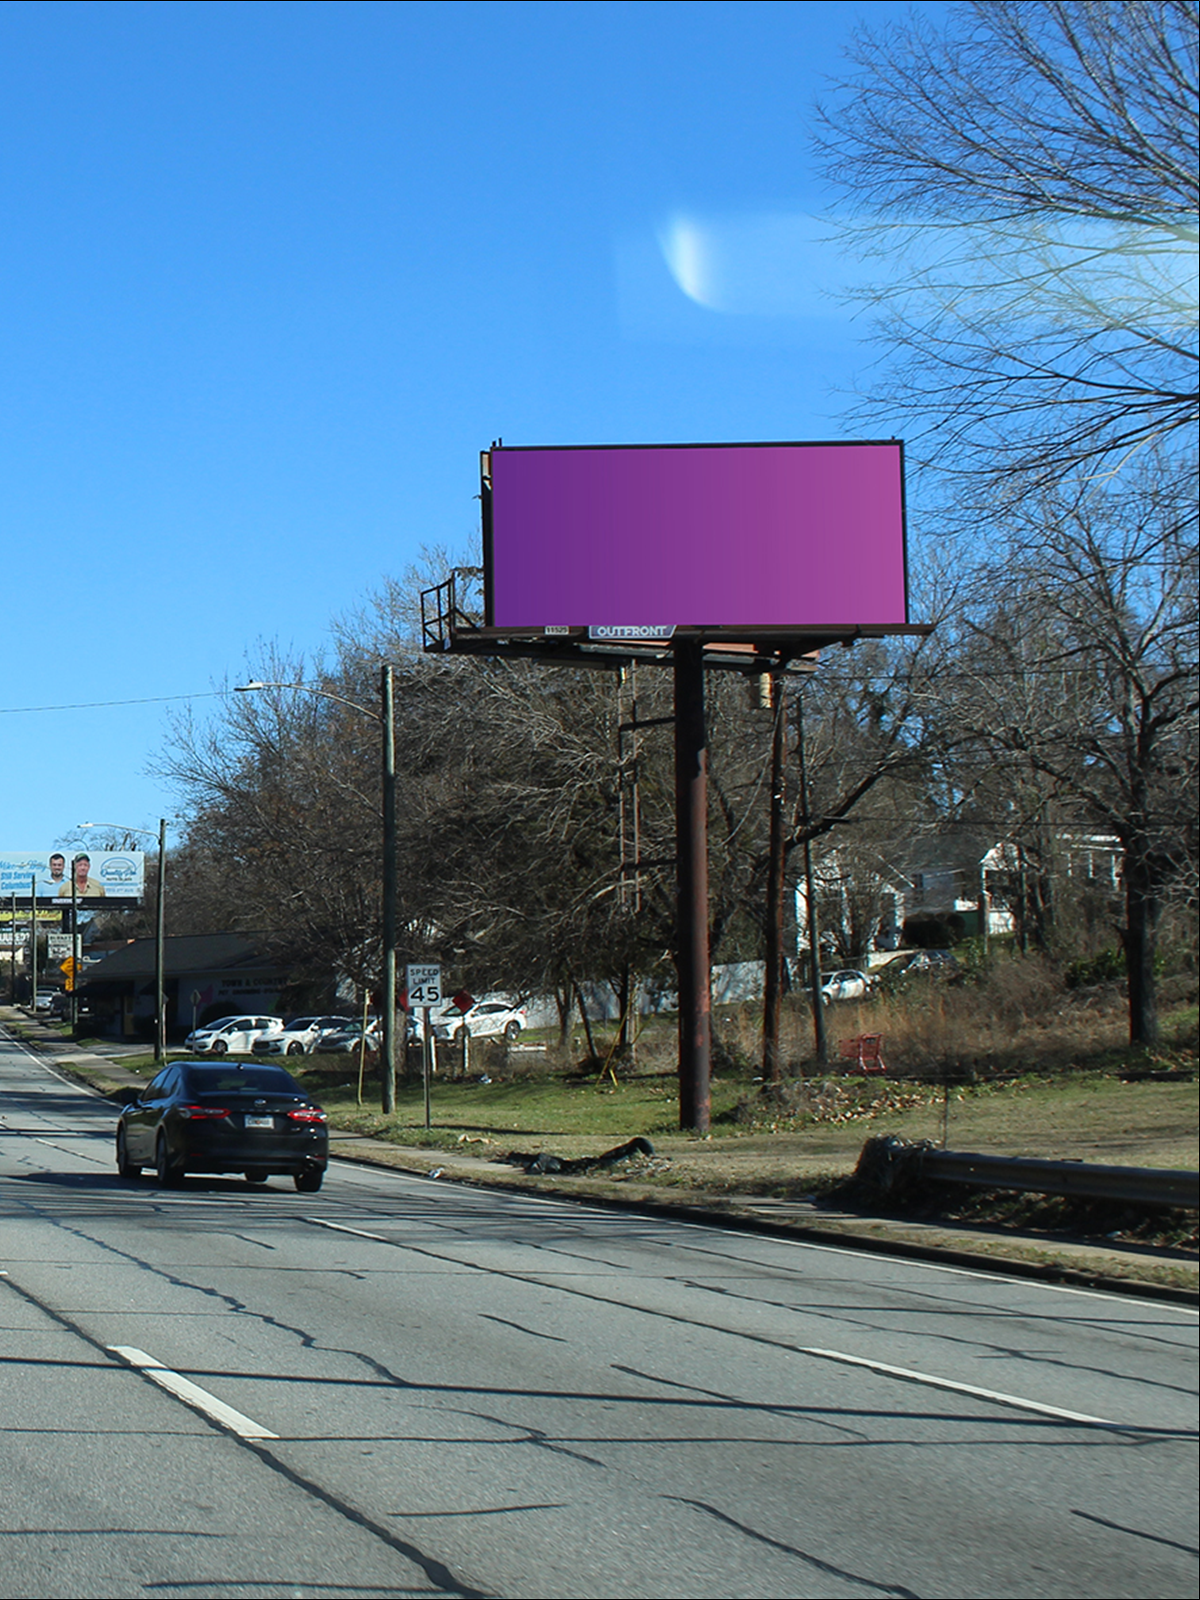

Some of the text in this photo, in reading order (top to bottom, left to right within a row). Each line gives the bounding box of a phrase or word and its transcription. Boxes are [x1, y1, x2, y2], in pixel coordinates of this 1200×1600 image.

[598, 626, 667, 636] OUTFRONT
[0, 872, 12, 880] Still
[409, 968, 439, 976] SPEED
[412, 977, 436, 985] LIMIT
[410, 986, 439, 1002] 45
